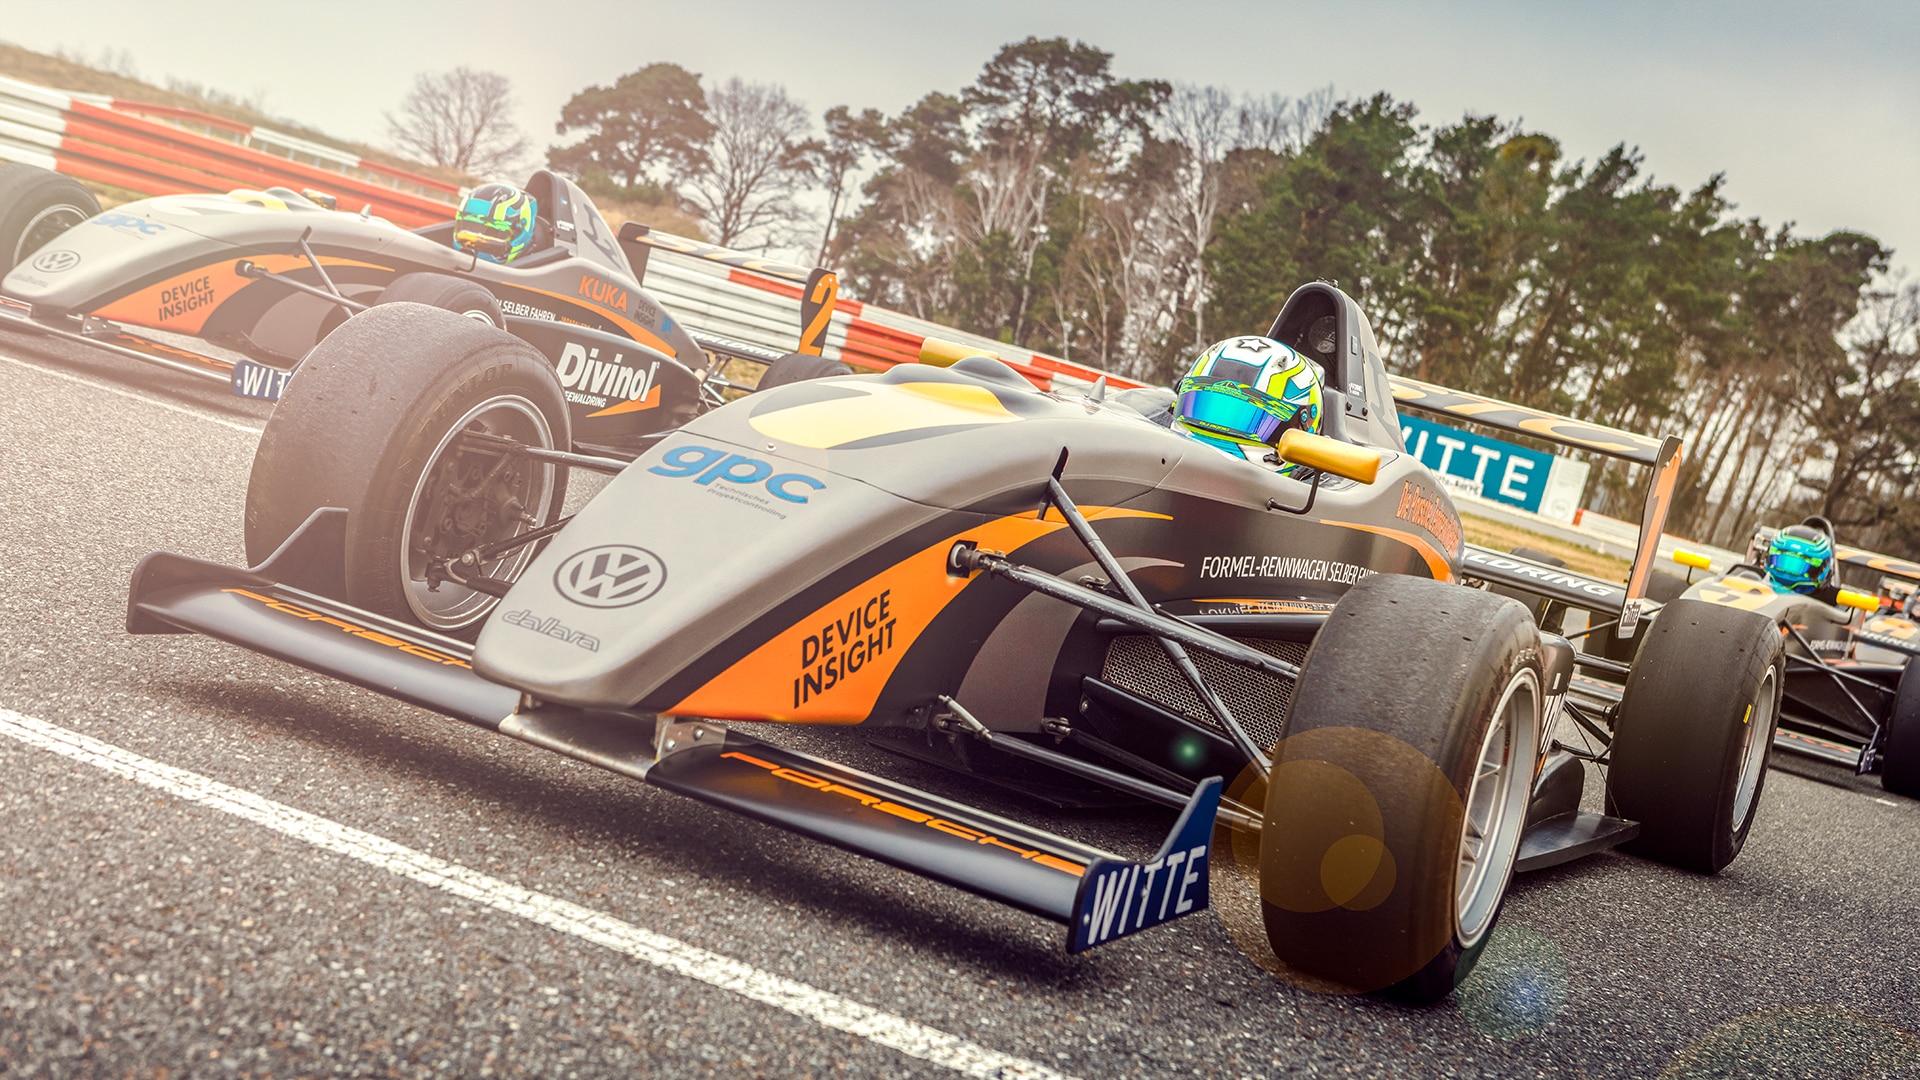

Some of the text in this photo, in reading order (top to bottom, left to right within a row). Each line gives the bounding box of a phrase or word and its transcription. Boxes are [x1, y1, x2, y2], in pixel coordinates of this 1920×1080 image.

[158, 290, 215, 321] INSIGHT
[161, 276, 210, 304] DEVICE
[501, 300, 529, 317] SELBER
[529, 307, 556, 321] FAHREN
[578, 274, 627, 313] KUKA
[798, 273, 839, 357] 2
[556, 342, 656, 402] Divinol
[647, 445, 827, 504] gpc
[714, 483, 770, 505] Technisches
[706, 488, 787, 520] Projektcontrolling
[1200, 556, 1329, 580] FORMEL-RENNWAGEN
[1327, 561, 1359, 585] SELBER
[502, 610, 600, 653] dallara
[802, 589, 890, 669] DEVICE
[794, 618, 897, 709] INSIGHT
[720, 752, 1086, 876] PORSCHE
[1088, 845, 1207, 945] WITTE
